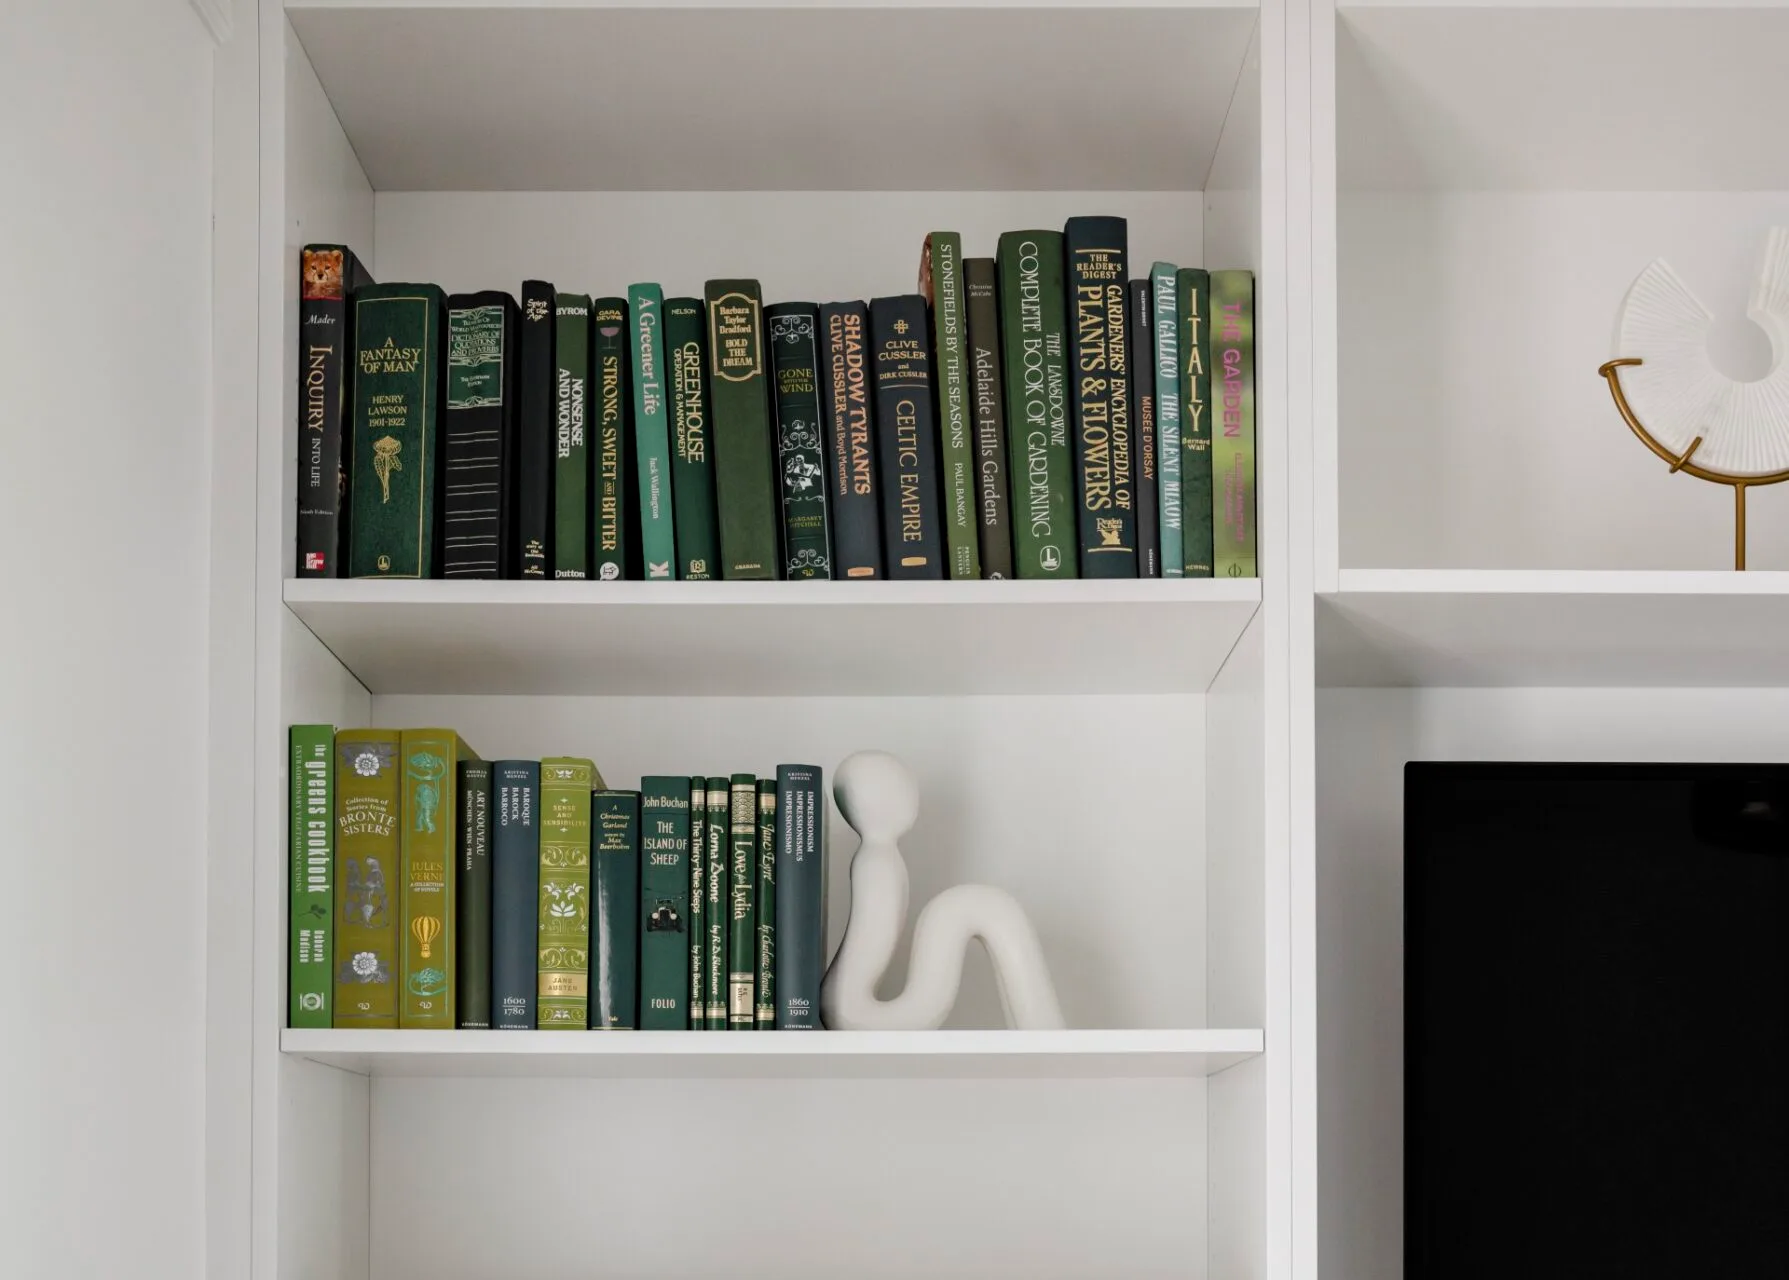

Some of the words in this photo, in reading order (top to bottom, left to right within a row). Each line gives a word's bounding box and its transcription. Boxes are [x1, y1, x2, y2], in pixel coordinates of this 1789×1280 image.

[1076, 262, 1122, 271] READER'S
[1090, 253, 1109, 262] THE
[940, 244, 957, 334] STONEFIELDS
[1019, 241, 1041, 332] COMPLETE
[1082, 270, 1117, 279] DIGEST
[527, 299, 547, 308] Spirit
[638, 297, 656, 310] A
[720, 307, 749, 315] Barbara
[1157, 275, 1177, 314] PAUL
[305, 314, 336, 325] Mader
[556, 307, 588, 316] BYROM
[671, 308, 696, 316] NELSON
[724, 316, 747, 325] Taylor
[1078, 284, 1106, 372] PLANTS
[1222, 303, 1242, 342] THE
[385, 337, 395, 348] A
[640, 312, 657, 379] Greener
[720, 325, 752, 334] Bradford
[726, 339, 748, 348] HOLD
[829, 314, 844, 353] CLIVE
[886, 341, 919, 350] CLIVE
[946, 336, 957, 354] BY
[1046, 332, 1061, 356] THE
[1107, 285, 1125, 375] GARDENERS'
[361, 348, 422, 366] FANTASY
[723, 357, 753, 367] DREAM
[729, 348, 748, 357] THE
[844, 314, 865, 402] SHADOW
[879, 351, 926, 361] CUSSLER
[1159, 320, 1178, 379] GALLICO
[1187, 288, 1203, 432] ITALY
[365, 361, 381, 373] OF
[384, 361, 415, 372] MAN
[559, 368, 571, 398] AND
[674, 348, 684, 392] OPERATION
[778, 368, 814, 379] GONE
[880, 372, 897, 380] DIRK
[947, 356, 960, 384] THE
[976, 347, 996, 415] Adelaide
[1024, 338, 1045, 395] BOOK
[373, 395, 404, 405] HENRY
[601, 356, 618, 424] STRONG,
[643, 382, 661, 416] Life
[780, 383, 814, 393] WIND
[832, 355, 847, 414] CUSSLER
[1081, 376, 1107, 398] &
[1223, 347, 1243, 438] GARDEN
[369, 406, 407, 415] LAWSON
[571, 378, 584, 447] NONSENSE
[683, 342, 705, 464] GREENHOUSE
[949, 386, 964, 449] SEASONS
[1027, 400, 1046, 426] OF
[1048, 364, 1066, 447] LANSDOWNE
[1161, 393, 1179, 421] THE
[369, 418, 406, 428] 1901-1922
[558, 400, 571, 458] WONDER
[676, 402, 687, 457] MANAGEMENT
[836, 431, 847, 448] Boyd
[896, 399, 918, 468] CELTIC
[980, 419, 998, 457] Hills
[1111, 378, 1130, 485] ENCYCLOPEDIA
[311, 437, 322, 464] INTO
[602, 428, 617, 479] SWEET
[850, 407, 871, 496] TYRANTS
[1082, 401, 1112, 511] FLOWERS
[1143, 436, 1154, 480] D'ORSAY
[1162, 425, 1180, 476] SILENT
[1182, 438, 1211, 446] Bernard
[311, 466, 321, 488] LIFE
[838, 448, 849, 496] Morrison
[954, 462, 965, 487] PAUL
[1027, 431, 1051, 538] GARDENING
[651, 475, 660, 520] Wallington
[901, 474, 922, 542] EMPIRE
[956, 488, 966, 528] BANGAY
[982, 461, 1001, 526] Gardens
[1115, 489, 1130, 510] OF
[1164, 480, 1181, 530] MIAOW
[602, 496, 617, 551] BITTER
[555, 570, 586, 578] Dutton
[314, 744, 326, 757] the
[295, 744, 303, 808] EXTRAORDINARY
[305, 761, 327, 815] greens
[345, 797, 379, 805] Collection
[476, 790, 486, 808] ART
[501, 787, 509, 826] BARROCO
[511, 787, 519, 821] BAROCK
[521, 787, 531, 826] BAROQUE
[643, 796, 660, 808] John
[660, 796, 689, 808] Buchan
[295, 809, 303, 860] VEGETARIAN
[343, 823, 390, 836] SISTERS
[476, 810, 486, 856] NOUVEAU
[656, 821, 676, 834] THE
[692, 819, 703, 837] The
[761, 823, 775, 850] Jane
[785, 791, 793, 854] IMPRESIONISMO
[796, 791, 804, 862] IMPRESSIONISMUS
[807, 791, 815, 853] IMPRESSIONISM
[308, 821, 331, 893] cookbook
[643, 837, 675, 850] ISLAND
[676, 838, 688, 850] OF
[710, 823, 724, 859] Lorna
[734, 841, 752, 873] Love
[650, 852, 680, 865] SHEEP
[691, 837, 703, 889] Thirty-Nine
[710, 862, 724, 903] Doone
[691, 890, 702, 914] Steps
[731, 884, 752, 920] Lydia
[711, 924, 721, 934] by
[299, 929, 312, 963] Madison
[314, 929, 325, 963] Deborah
[762, 935, 775, 970] Charlotte
[693, 954, 701, 972] John
[712, 954, 721, 996] Blackmore
[503, 997, 527, 1005] 1600
[693, 973, 701, 998] Buchan
[788, 998, 810, 1006] 1860
[503, 1007, 526, 1016] 1780
[651, 998, 676, 1009] FOLIO
[790, 1009, 809, 1017] 1910
